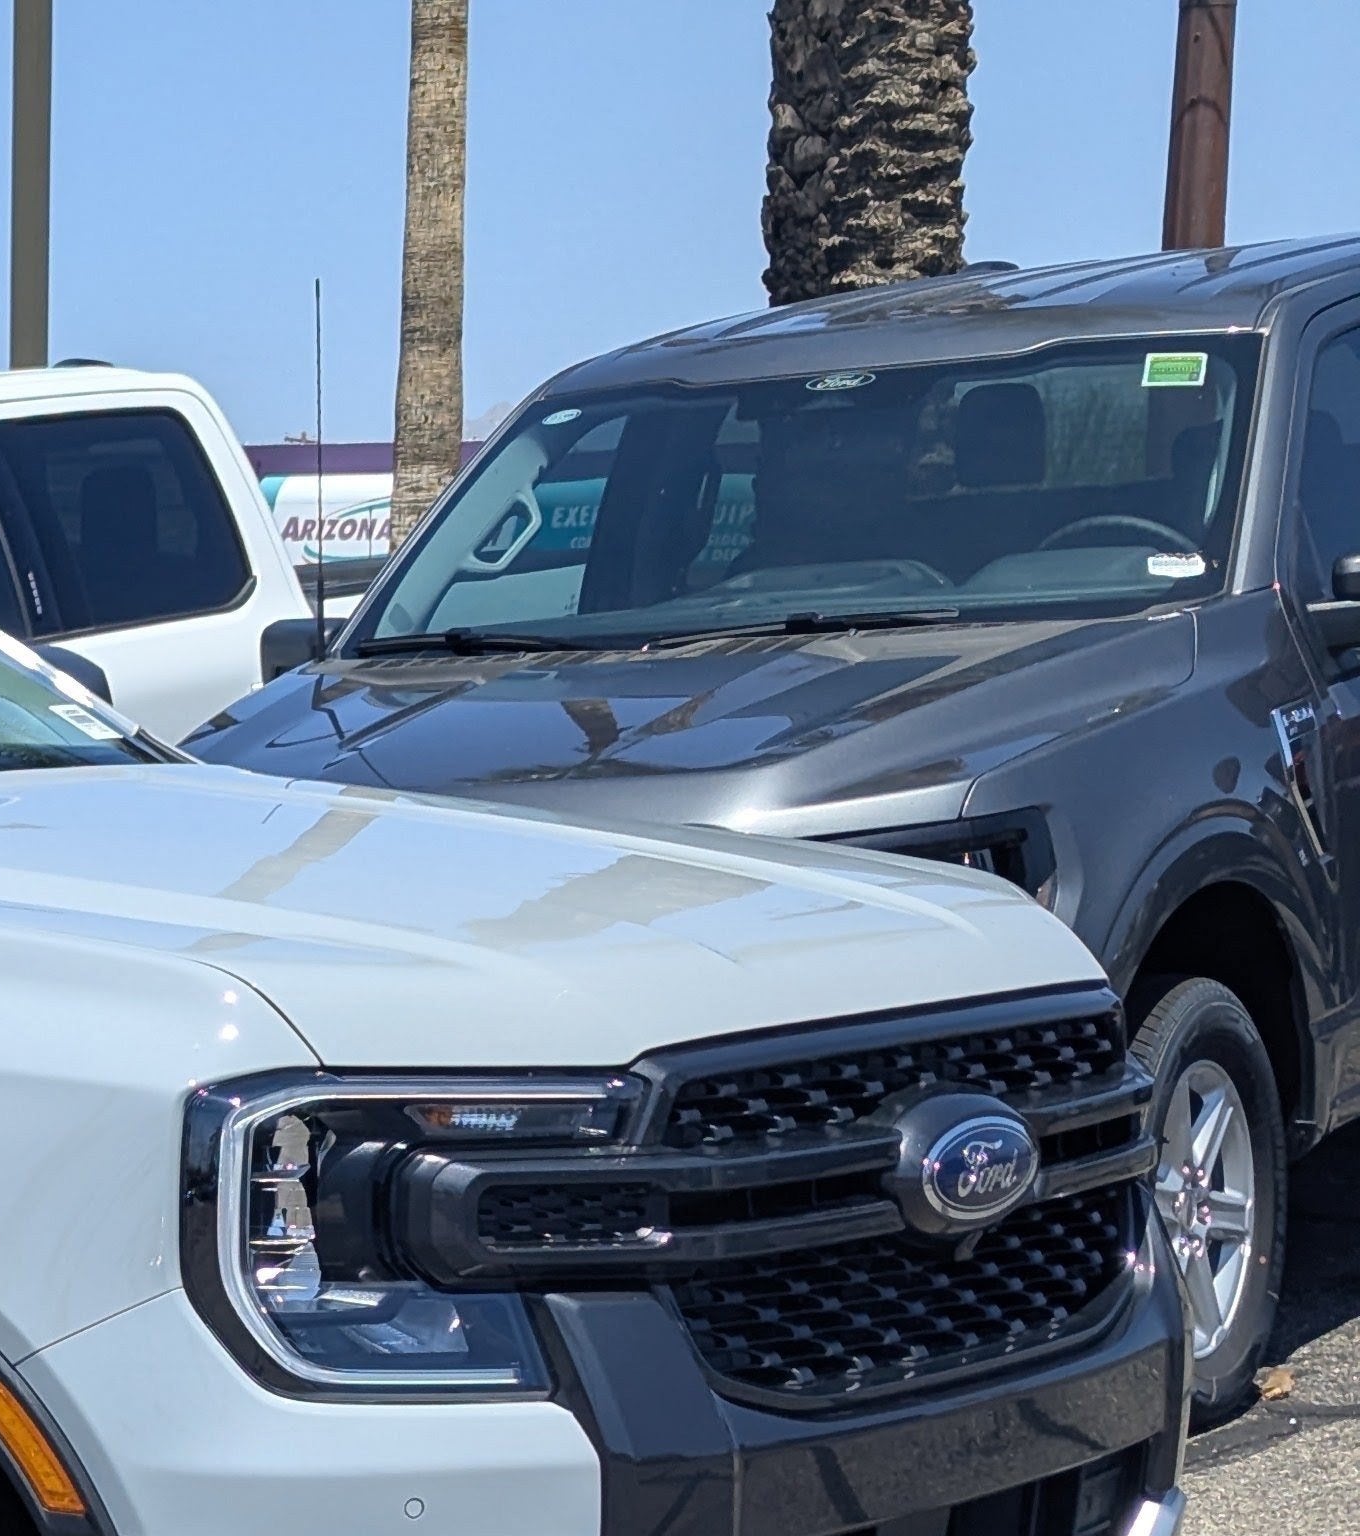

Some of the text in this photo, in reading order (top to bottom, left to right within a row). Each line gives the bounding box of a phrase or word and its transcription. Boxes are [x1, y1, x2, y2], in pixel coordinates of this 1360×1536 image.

[816, 373, 865, 389] Ford
[281, 516, 391, 542] ARIZONA
[956, 1139, 1019, 1198] Ford
